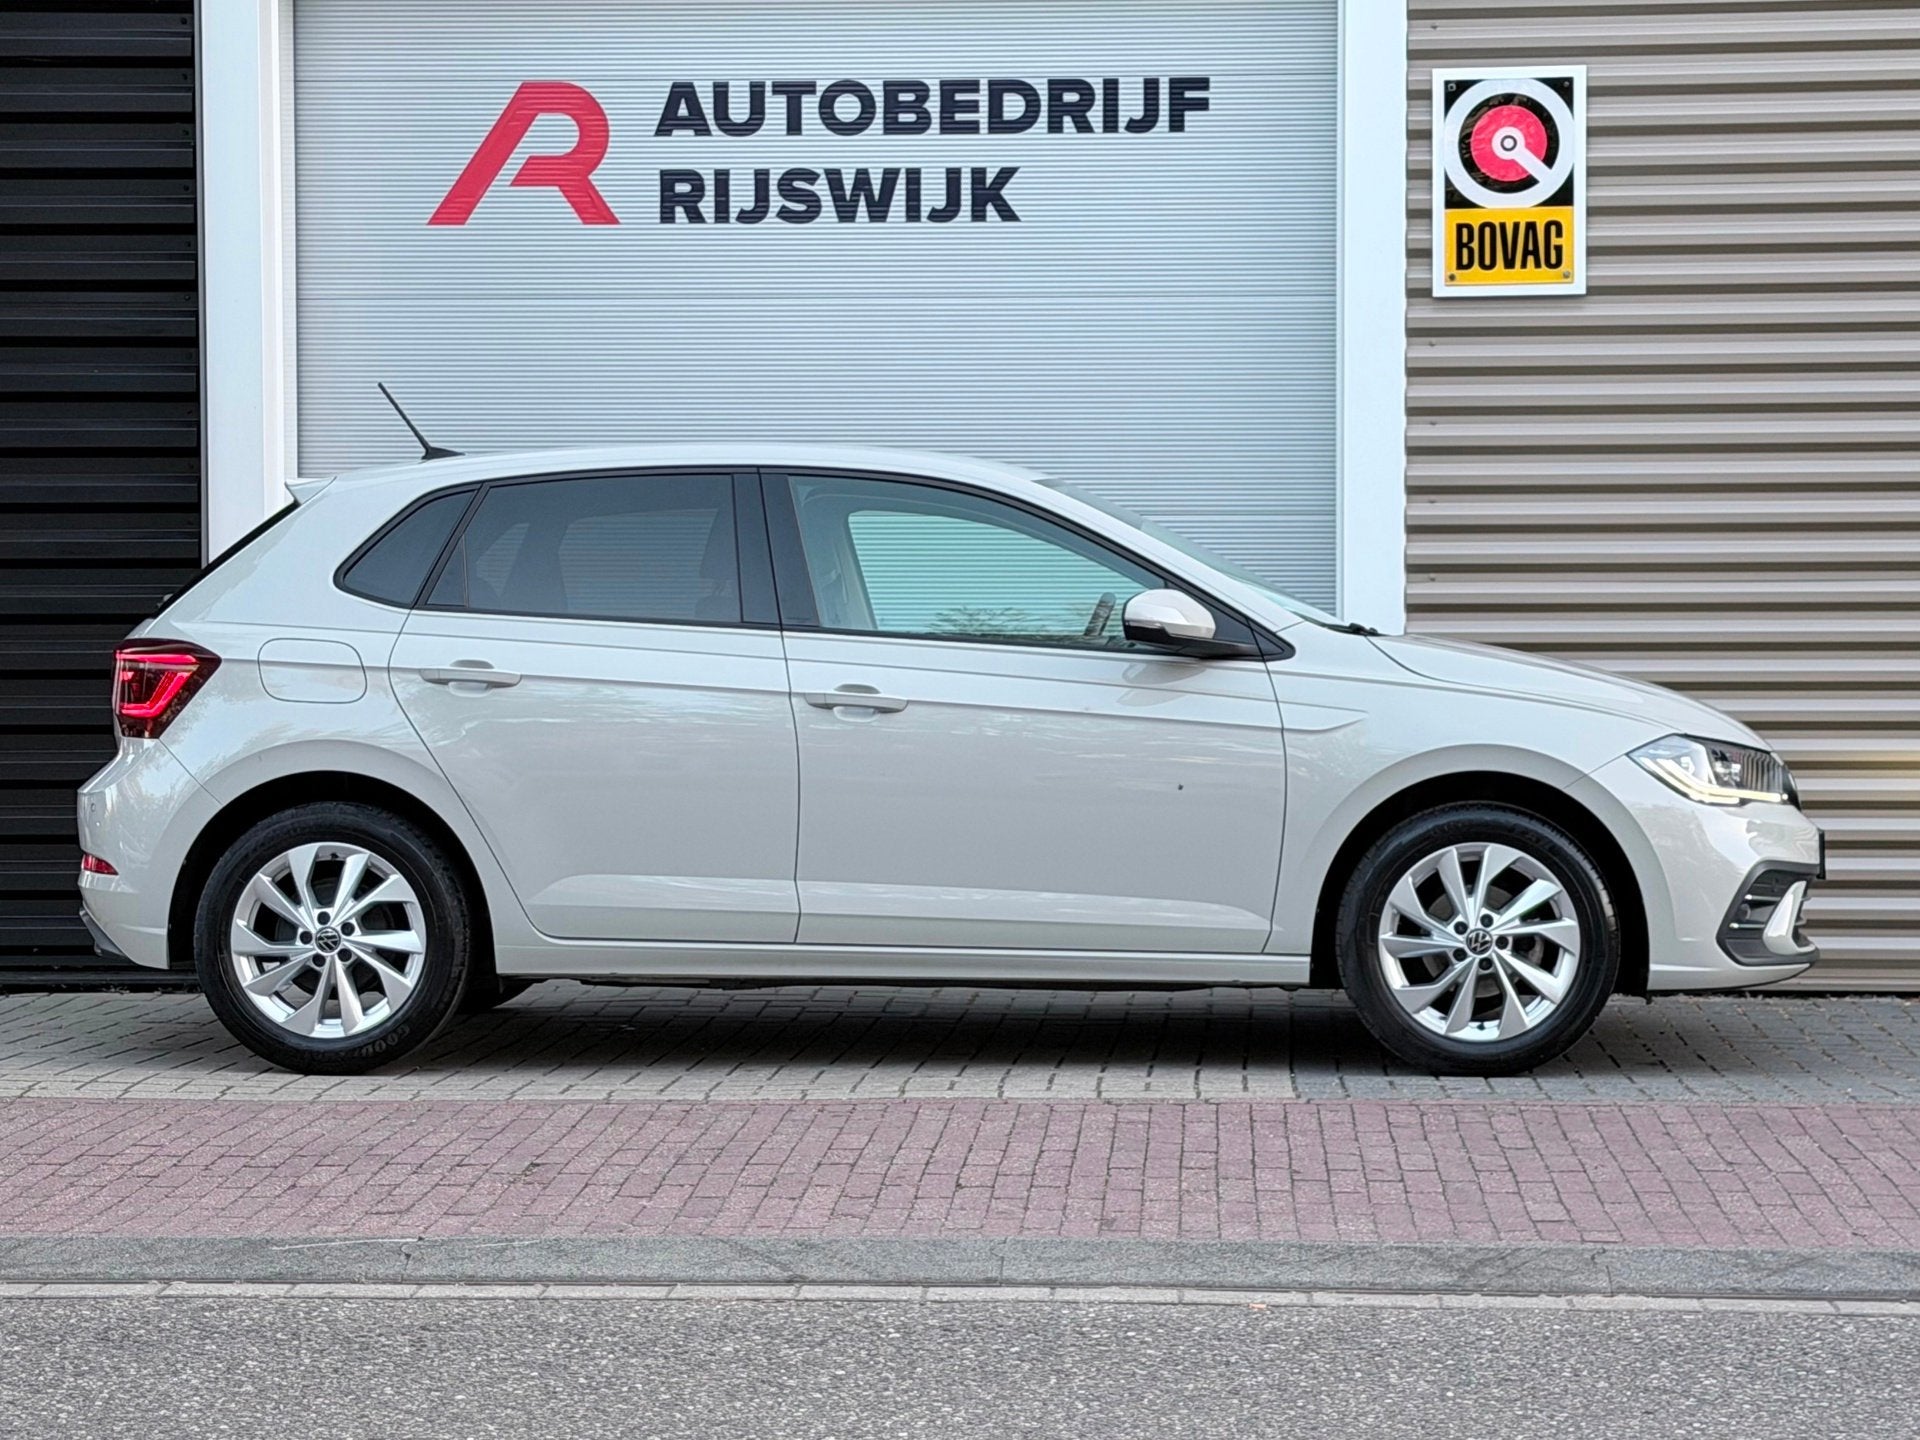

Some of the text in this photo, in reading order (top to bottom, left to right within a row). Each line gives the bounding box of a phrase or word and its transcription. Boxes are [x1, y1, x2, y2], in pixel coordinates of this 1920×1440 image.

[654, 77, 1211, 137] AUTOBEDRIJF
[659, 167, 1020, 224] RIJSWIJK
[1456, 220, 1563, 270] BOVAG
